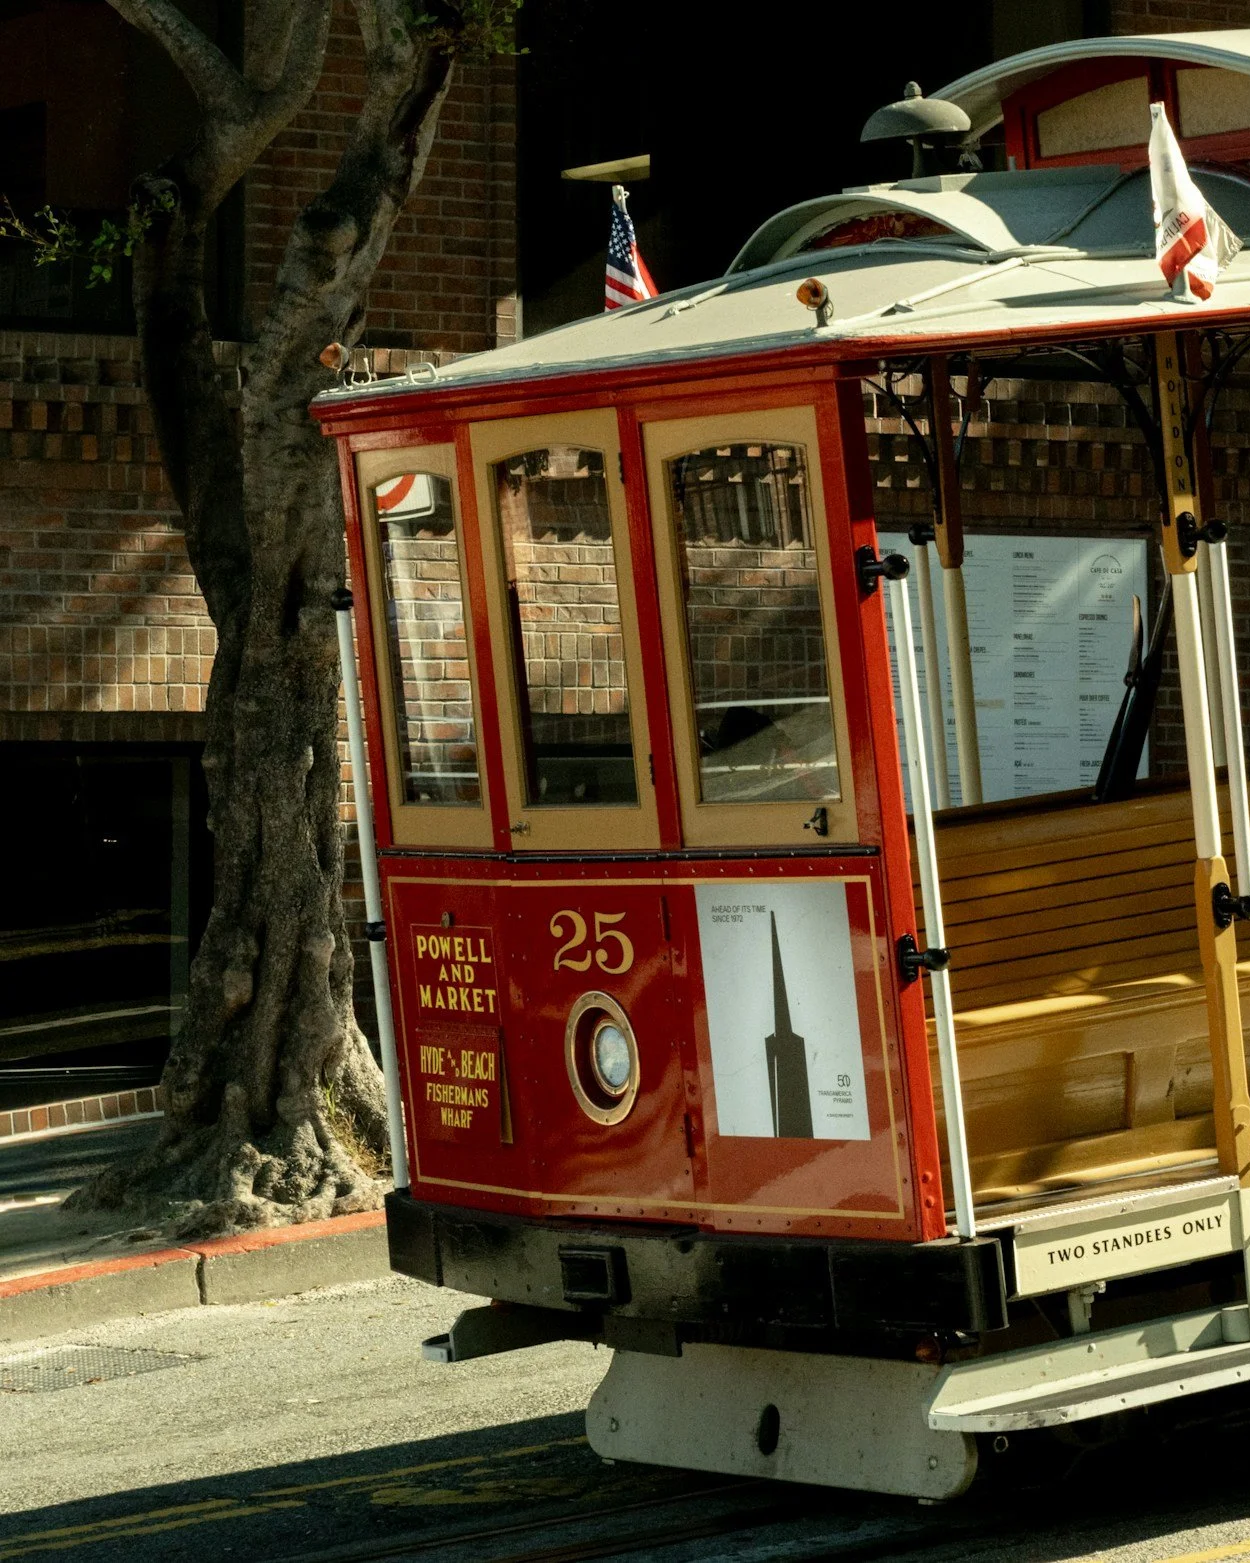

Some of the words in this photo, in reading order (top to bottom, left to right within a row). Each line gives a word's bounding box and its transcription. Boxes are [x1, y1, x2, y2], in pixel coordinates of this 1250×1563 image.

[1165, 356, 1180, 438] HOLD
[1175, 455, 1185, 491] ON
[711, 905, 731, 914] AHEAD
[732, 905, 740, 913] OF
[742, 905, 751, 913] ITS
[752, 905, 766, 913] TIME
[712, 915, 729, 923] SINCE
[731, 915, 743, 923] 1972
[416, 934, 492, 964] POWELL
[550, 909, 634, 975] 25
[439, 964, 475, 984] AND
[419, 984, 497, 1014] MARKET
[420, 1045, 446, 1077] HYDE
[461, 1050, 496, 1082] BEACH
[426, 1082, 489, 1109] FISHERMANS
[441, 1107, 473, 1129] WHARF
[1047, 1244, 1085, 1265] TWO
[1092, 1225, 1172, 1257] STANDEES
[1182, 1213, 1223, 1236] ONLY
